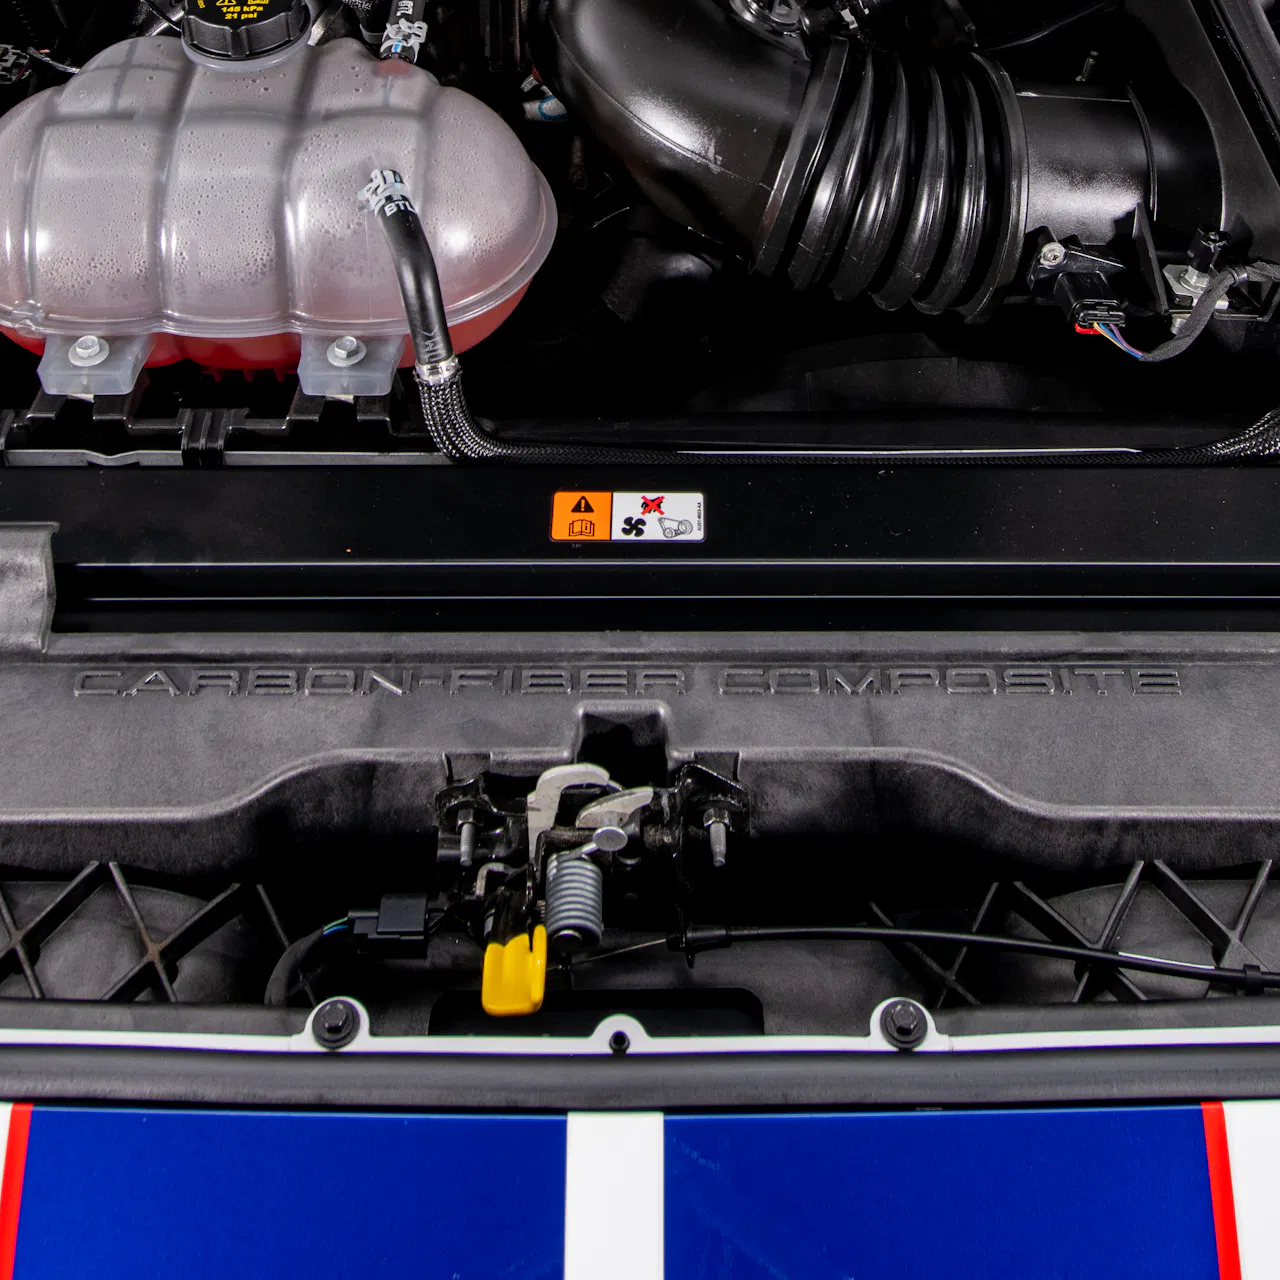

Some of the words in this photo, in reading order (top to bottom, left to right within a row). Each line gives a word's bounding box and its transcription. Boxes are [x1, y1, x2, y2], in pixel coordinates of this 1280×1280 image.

[221, 5, 241, 13] 145
[224, 12, 238, 20] 21
[240, 12, 258, 20] psi
[383, 200, 418, 218] BTL
[72, 667, 688, 698] CARBON-FIBER
[718, 667, 1183, 697] COMPOSITE
